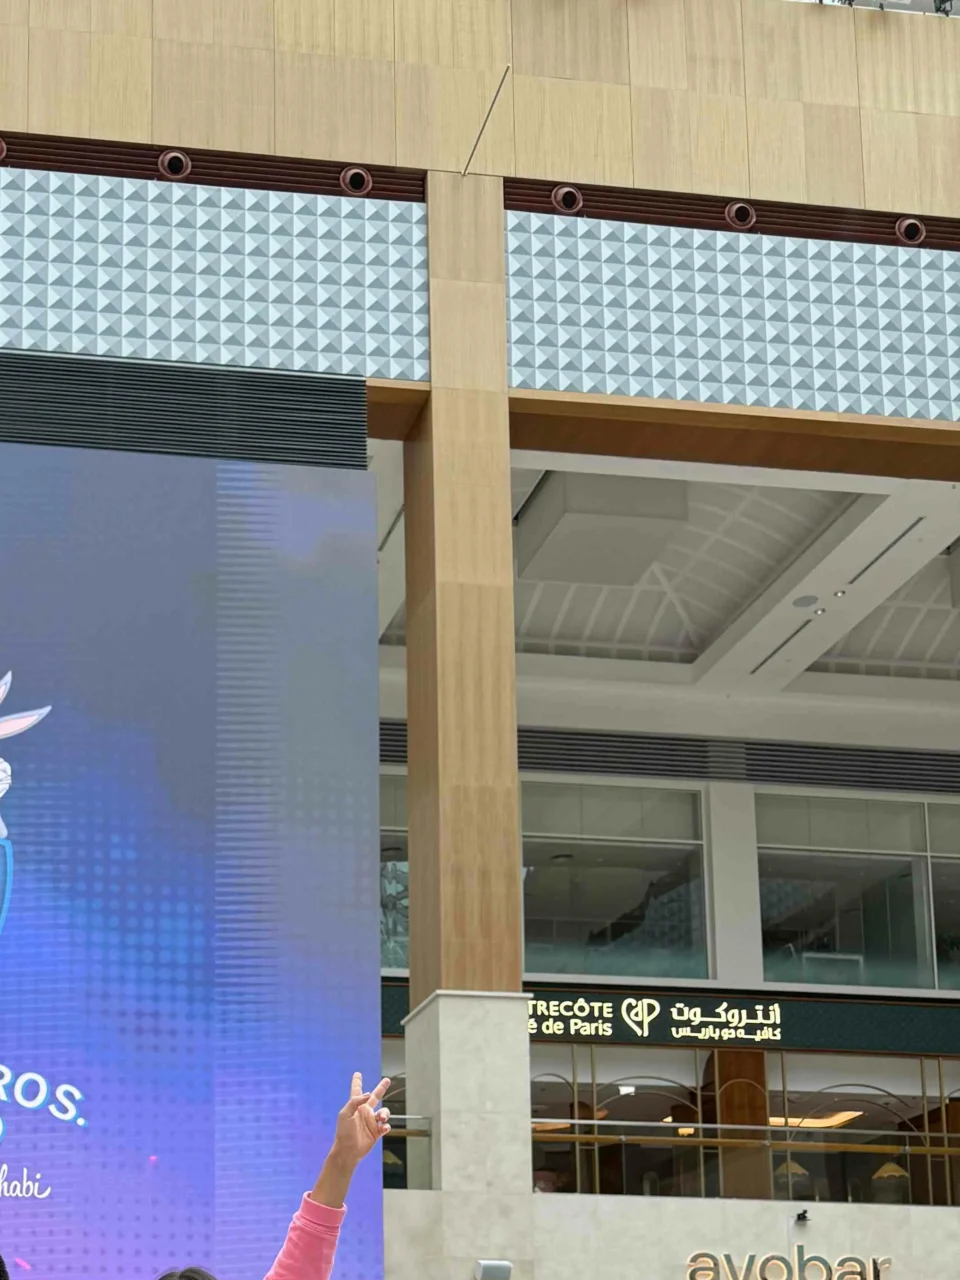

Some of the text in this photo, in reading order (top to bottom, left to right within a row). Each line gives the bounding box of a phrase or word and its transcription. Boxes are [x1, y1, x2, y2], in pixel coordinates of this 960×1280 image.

[527, 997, 614, 1018] TRECÔTE
[670, 1001, 781, 1027] أنتروكوت
[541, 1017, 565, 1035] de
[569, 1018, 613, 1036] Paris
